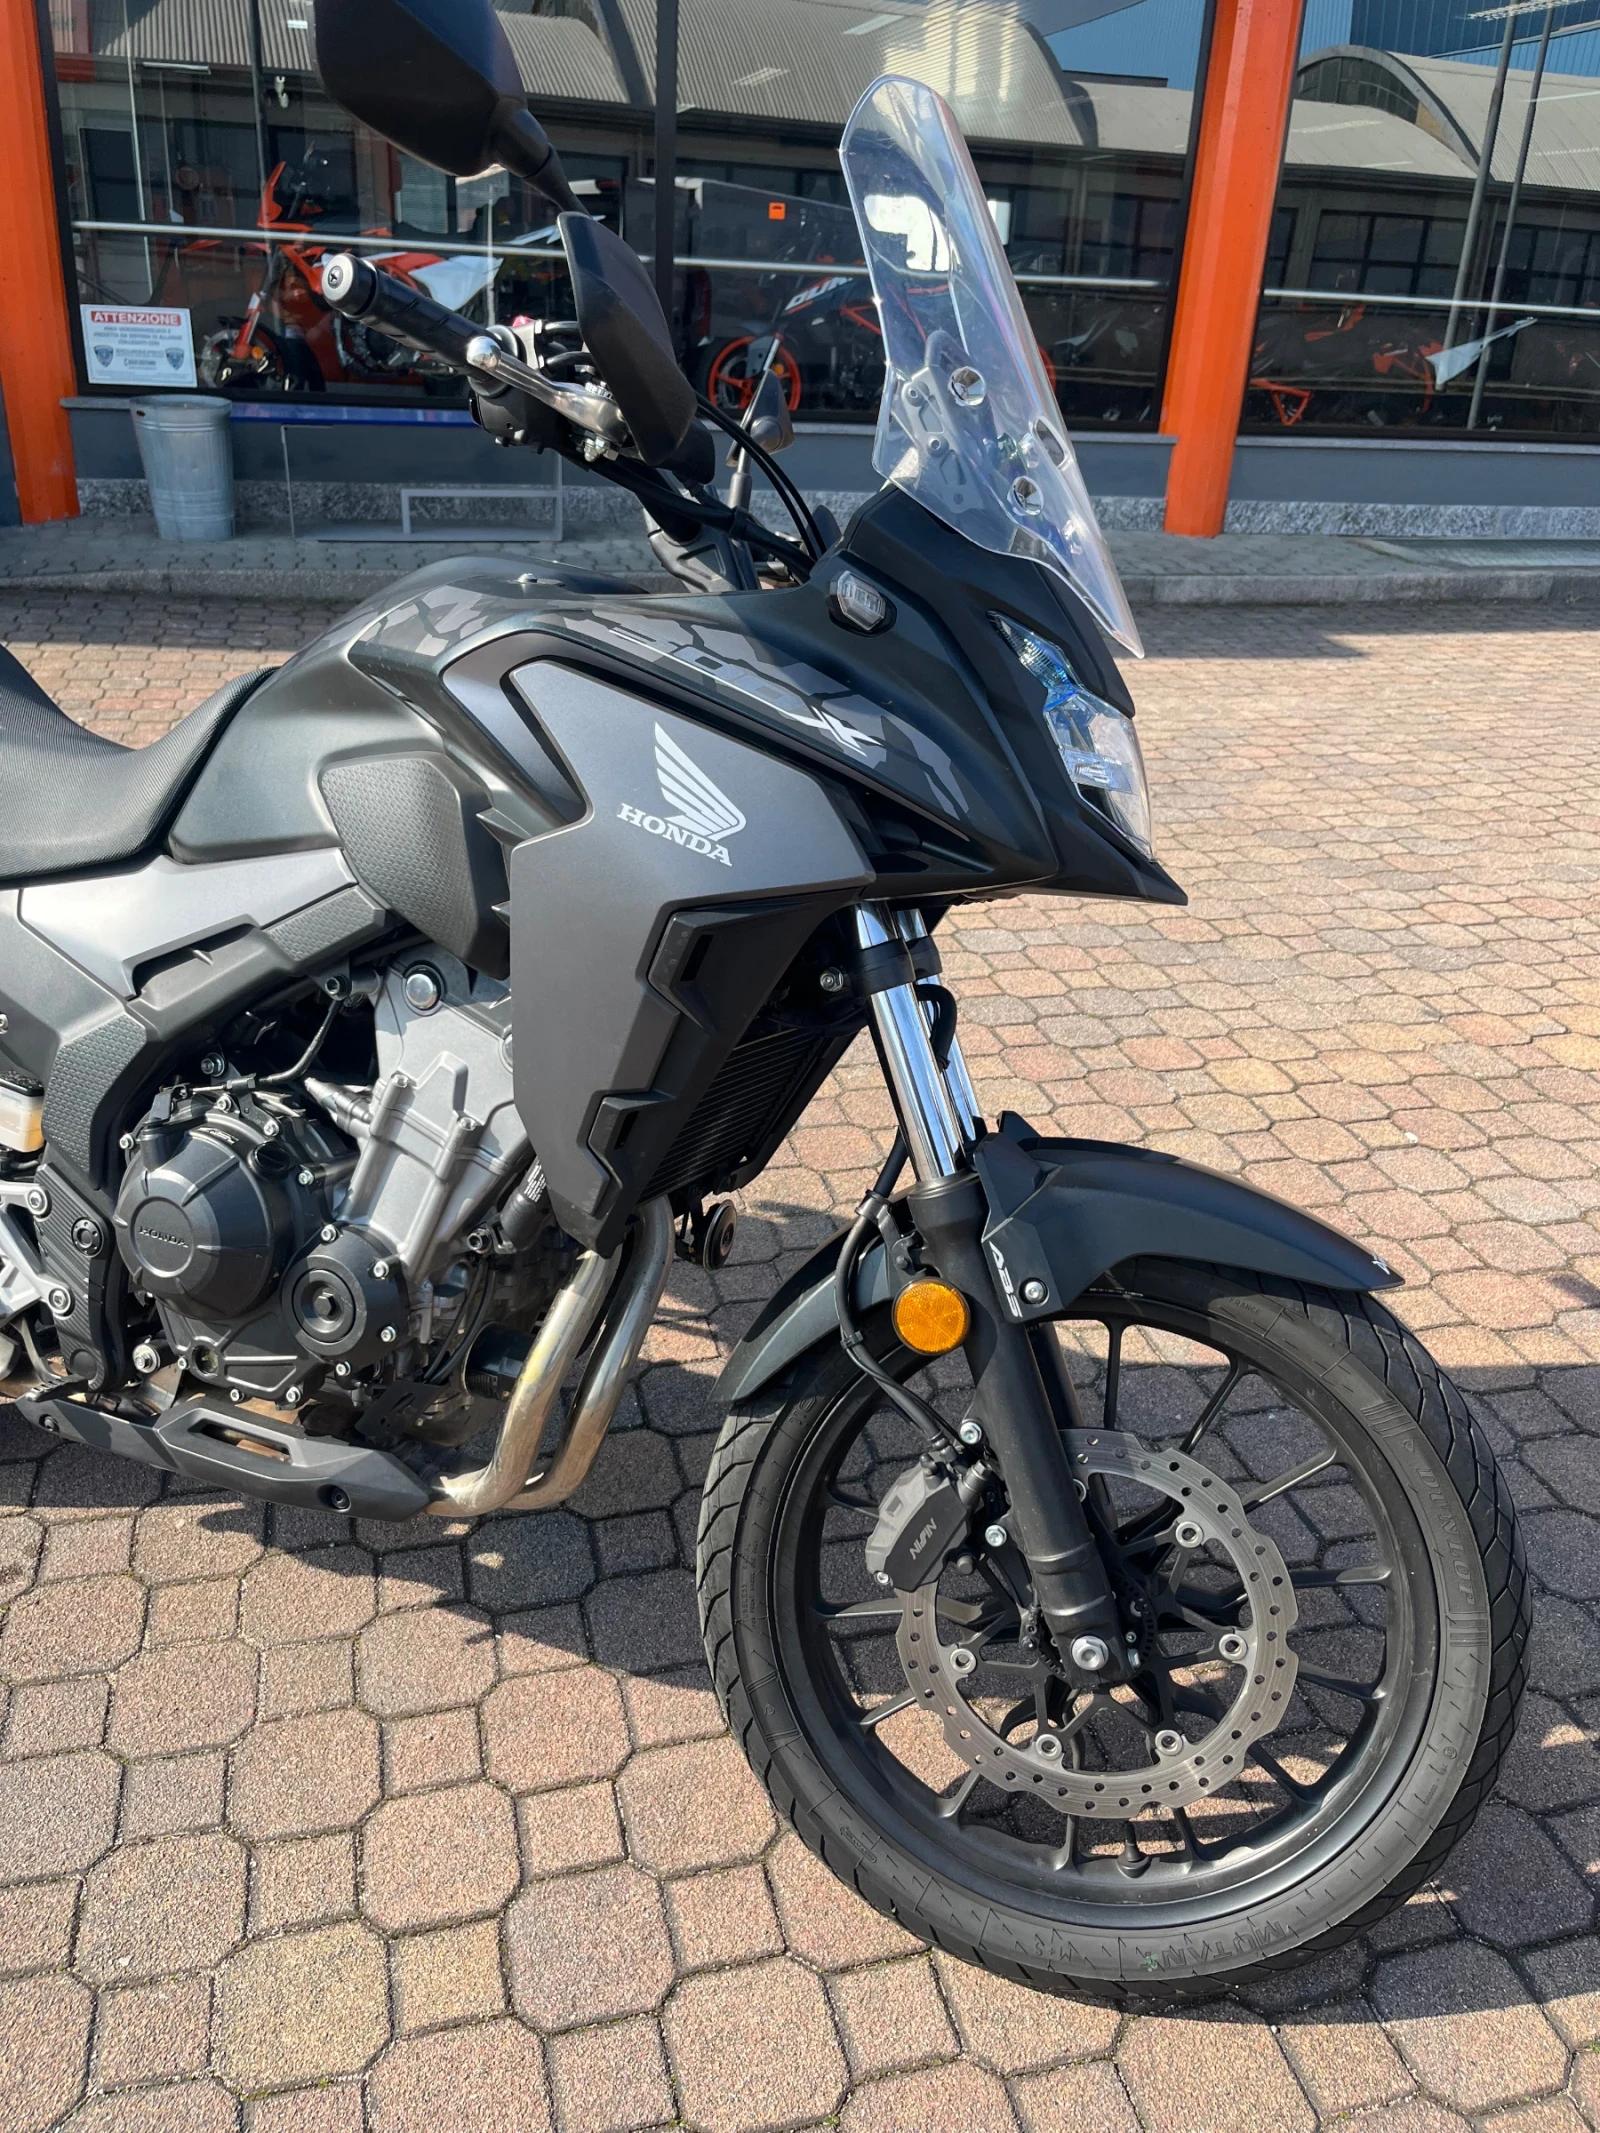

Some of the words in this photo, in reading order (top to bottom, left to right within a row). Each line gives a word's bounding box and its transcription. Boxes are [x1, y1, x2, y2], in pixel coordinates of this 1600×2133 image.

[93, 311, 179, 325] ATTENZIONE
[616, 802, 733, 867] HONDA
[139, 1226, 189, 1248] HONDA
[988, 1240, 1023, 1318] ABS
[1416, 1466, 1476, 1606] DUNLOP
